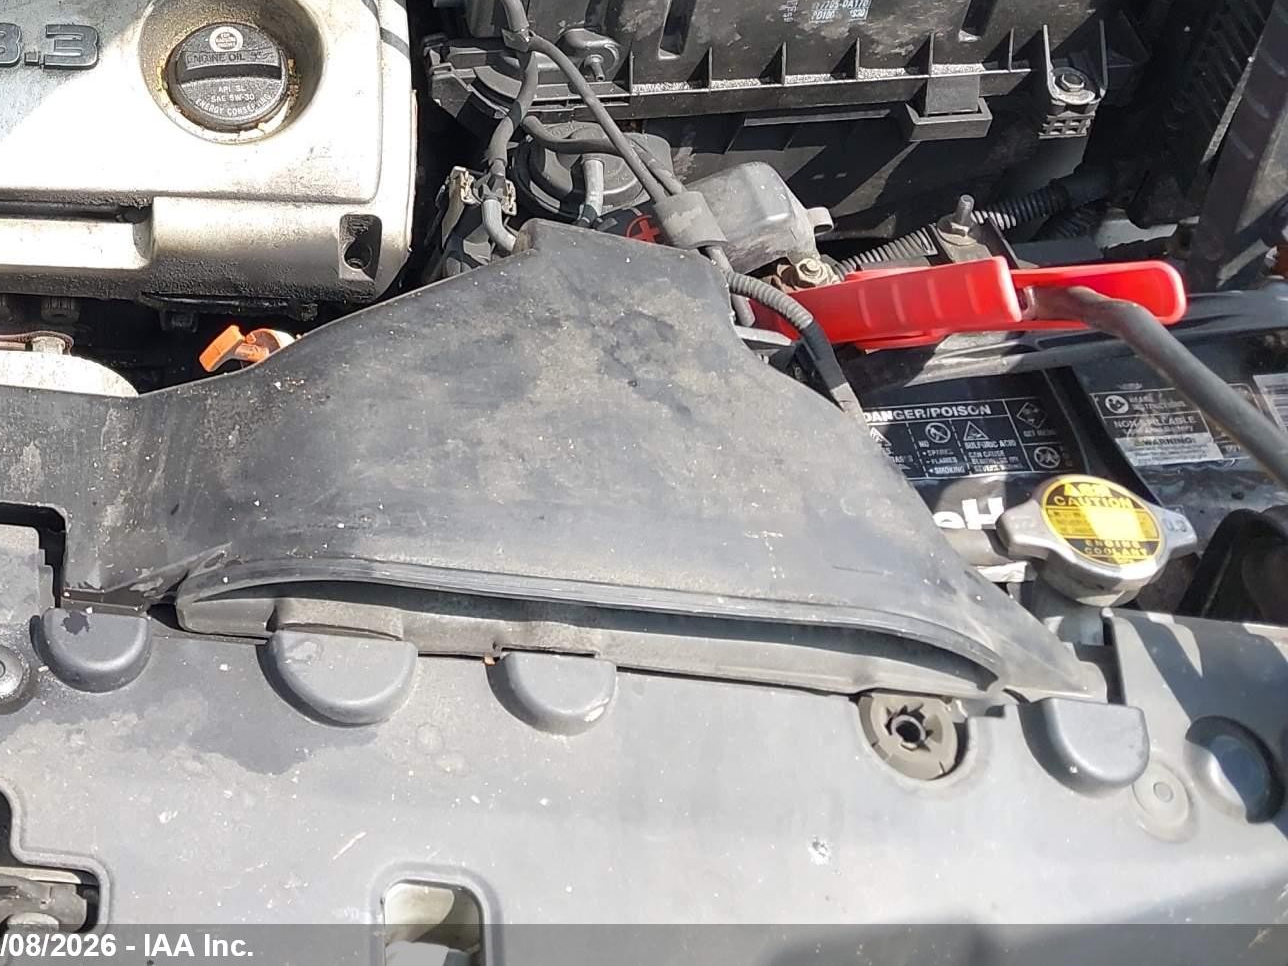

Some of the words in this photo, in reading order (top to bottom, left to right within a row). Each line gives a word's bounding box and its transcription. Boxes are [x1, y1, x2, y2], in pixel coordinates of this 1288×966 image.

[195, 98, 225, 114] ENERGY
[863, 404, 992, 423] DANGER/POISON
[1053, 495, 1133, 509] CAUTION
